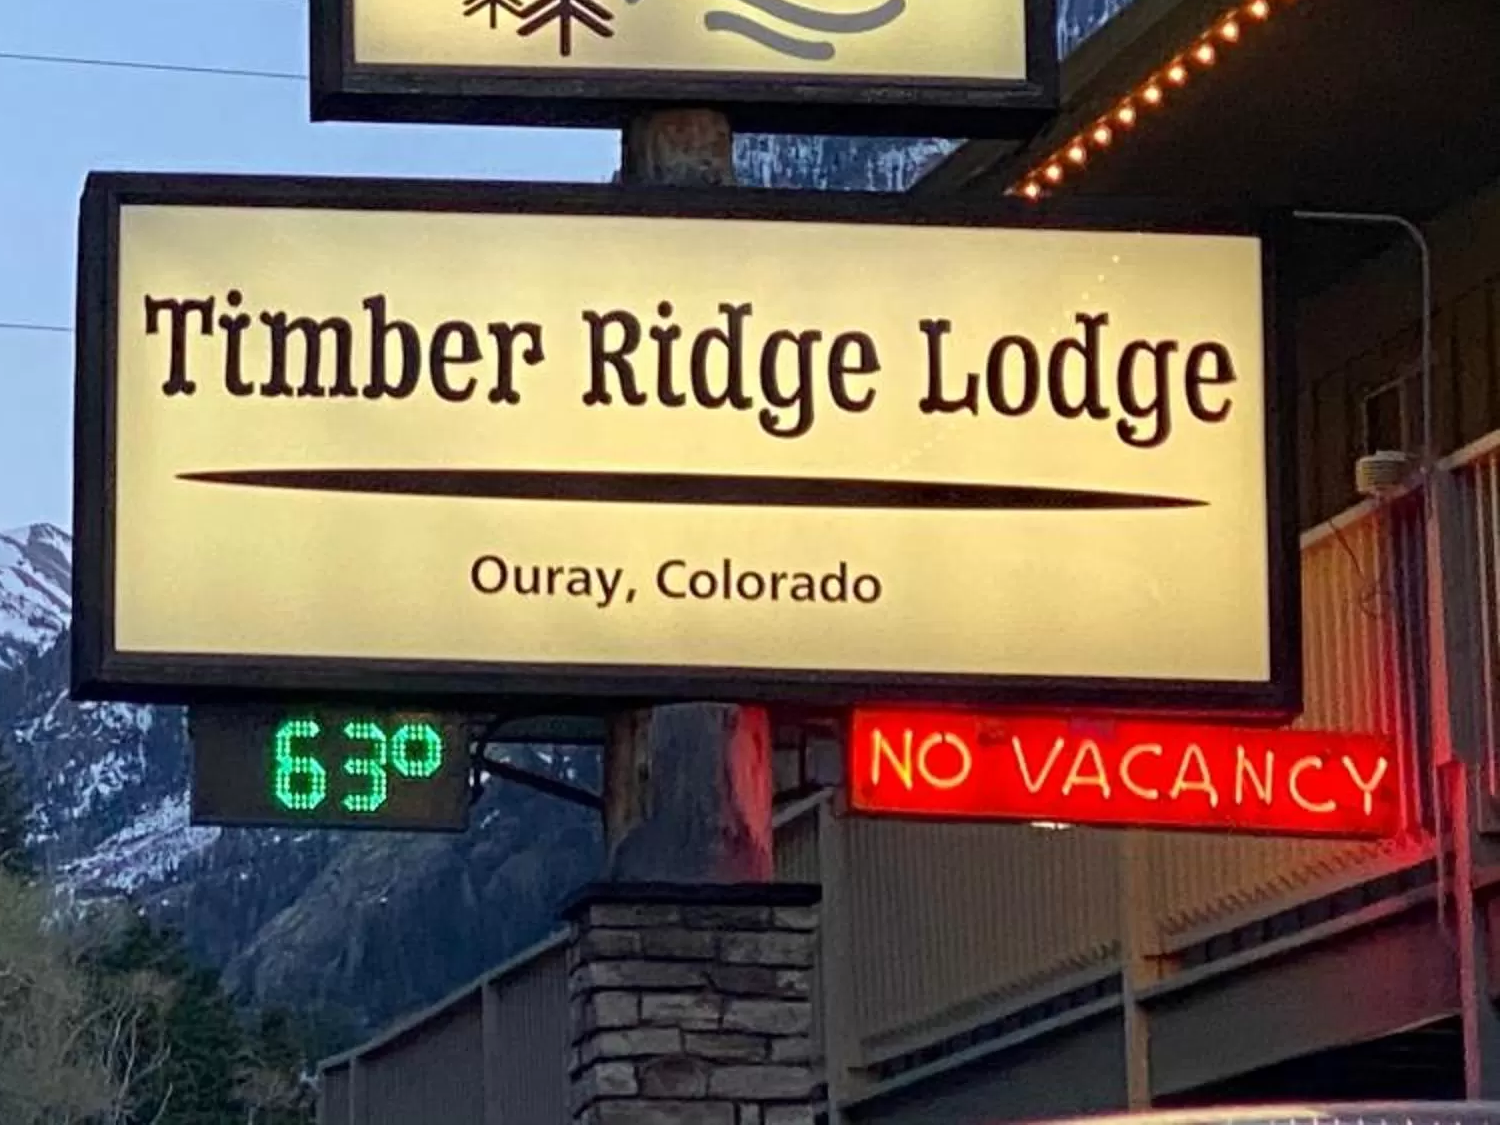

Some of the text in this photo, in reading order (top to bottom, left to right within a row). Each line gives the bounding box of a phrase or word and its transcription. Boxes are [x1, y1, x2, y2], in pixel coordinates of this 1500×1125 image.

[145, 290, 1236, 448] Timber Ridge Lodge
[471, 554, 882, 609] Ouray, Colorado
[870, 729, 1388, 815] NO VACANCY
